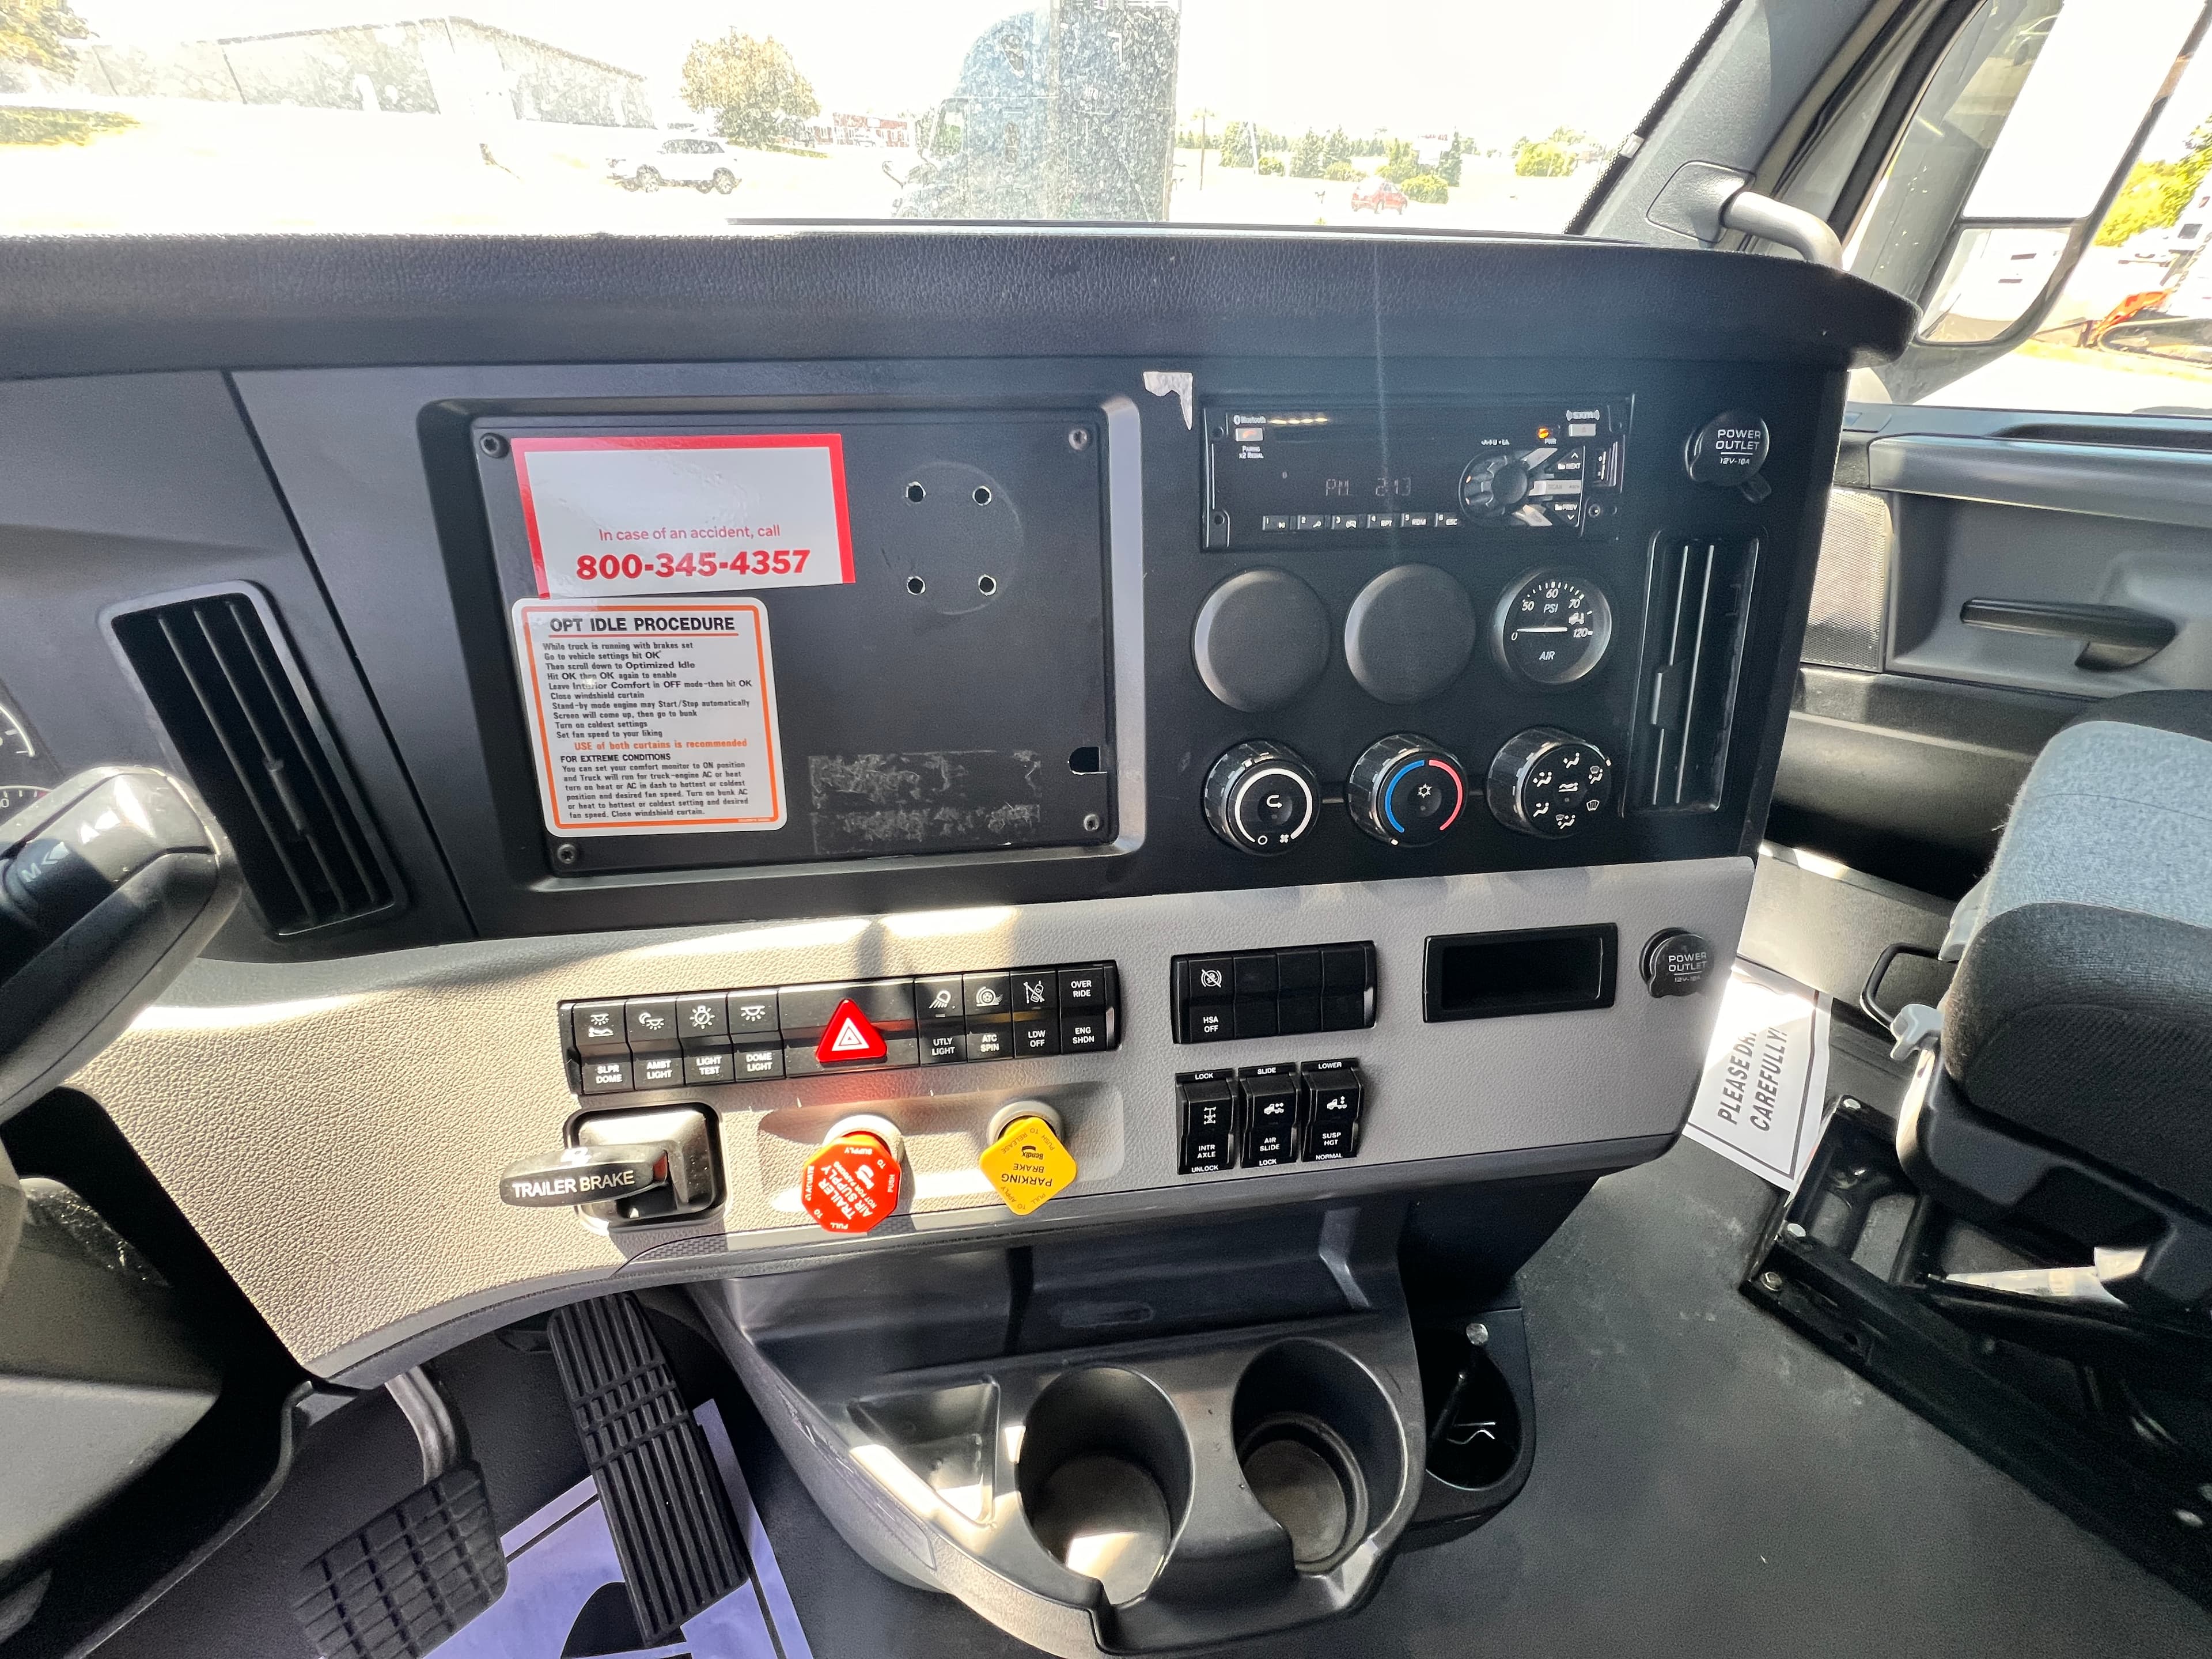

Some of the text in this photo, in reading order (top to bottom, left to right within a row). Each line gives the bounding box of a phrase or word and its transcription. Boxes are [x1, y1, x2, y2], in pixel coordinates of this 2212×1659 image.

[1718, 429, 1761, 438] POWER
[1715, 441, 1760, 450] OUTLET
[1326, 479, 1349, 496] PM
[599, 525, 780, 540] In case of an accident, call
[576, 550, 810, 580] 800-345-4357
[1546, 588, 1559, 598] 60
[1522, 601, 1535, 611] 50
[1544, 604, 1558, 613] PSI
[1569, 599, 1580, 608] 70
[550, 618, 735, 631] OPT IDLE PROCEDURE
[1511, 632, 1518, 641] 0
[1573, 628, 1588, 638] 120
[602, 642, 630, 650] running
[1539, 651, 1555, 660] AIR
[626, 661, 674, 670] Optimized
[619, 672, 639, 680] again
[658, 700, 698, 708] Start/Stop
[702, 699, 749, 707] automatically
[574, 742, 592, 750] USE
[609, 741, 629, 749] both
[634, 740, 671, 749] curtains
[687, 738, 747, 748] recommended
[623, 753, 671, 761] CONDITIONS
[22, 863, 41, 882] M
[1668, 952, 1707, 963] POWER
[1668, 961, 1707, 972] OUTLET
[1070, 980, 1092, 988] OVER
[1073, 989, 1091, 998] RIDE
[1203, 1016, 1218, 1024] HSA
[1075, 1027, 1091, 1035] ENG
[1204, 1024, 1218, 1033] OFF
[982, 1034, 997, 1043] ATC
[1028, 1030, 1046, 1039] LDW
[1073, 1035, 1094, 1044] SHDN
[933, 1037, 953, 1046] UTLY
[1030, 1039, 1045, 1048] OFF
[932, 1046, 956, 1056] LIGHT
[980, 1043, 999, 1052] SPIN
[696, 1056, 722, 1066] LIGHT
[746, 1052, 772, 1061] DOME
[597, 1065, 620, 1074] SLPR
[647, 1060, 671, 1070] AMBT
[699, 1065, 720, 1075] TEST
[747, 1062, 772, 1072] LIGHT
[596, 1074, 622, 1084] DOME
[647, 1069, 672, 1080] LIGHT
[1750, 1027, 1787, 1131] CAREFULLY!
[1717, 1055, 1750, 1126] PLEASE
[1001, 1132, 1028, 1154] RELEASE
[1041, 1135, 1055, 1151] PUSH
[1260, 1143, 1280, 1152] SLIDE
[1022, 1152, 1043, 1160] Bendix
[1197, 1150, 1216, 1158] AXLE
[877, 1160, 886, 1169] TO
[1013, 1163, 1044, 1173] BRAKE
[834, 1161, 857, 1187] PARKING
[512, 1170, 635, 1199] TRAILER BRAKE
[821, 1165, 858, 1202] SUPPLY
[1001, 1173, 1052, 1187] PARKING
[855, 1185, 866, 1198] FOR
[1001, 1187, 1017, 1203] APPLY
[818, 1178, 855, 1220] TRAILER
[864, 1197, 877, 1209] NOT
[1031, 1194, 1046, 1205] PULL
[854, 1200, 873, 1217] AIR
[814, 1209, 823, 1219] TO
